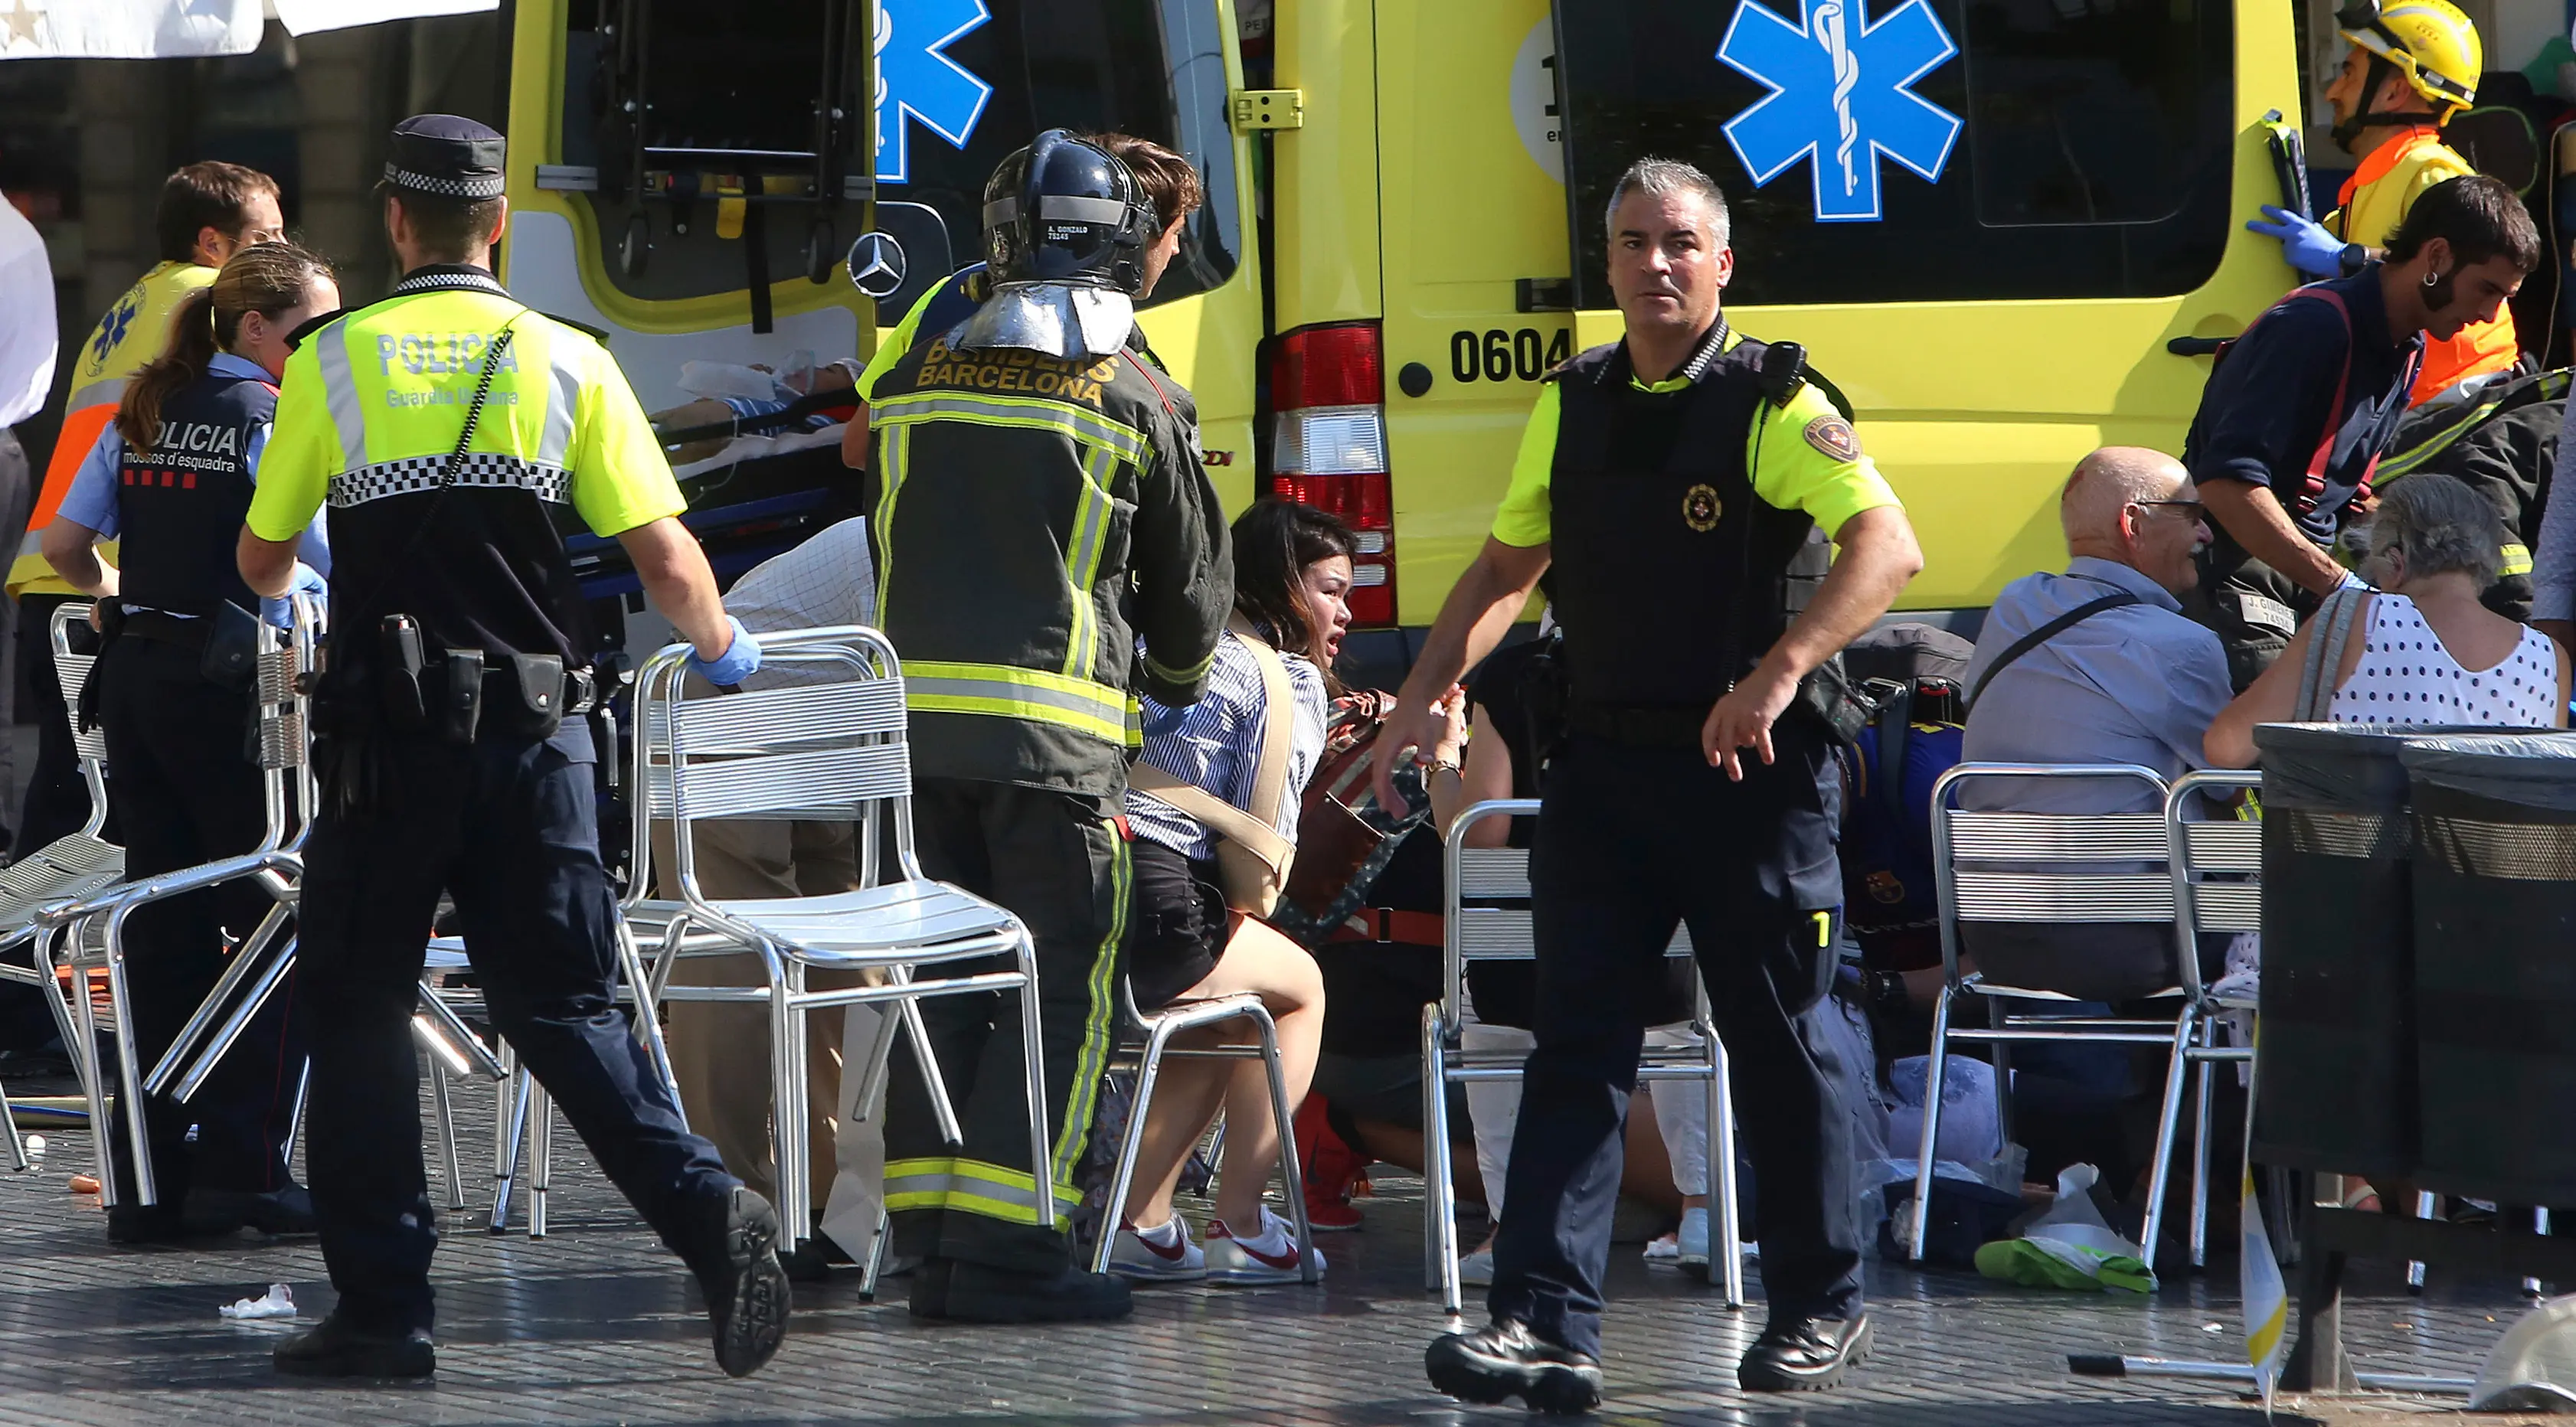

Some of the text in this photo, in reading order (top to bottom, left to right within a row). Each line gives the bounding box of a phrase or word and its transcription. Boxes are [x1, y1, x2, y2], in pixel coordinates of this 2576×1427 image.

[377, 333, 518, 376] POLICIA
[1451, 328, 1570, 383] 0604
[916, 364, 1103, 408] BARCELONA
